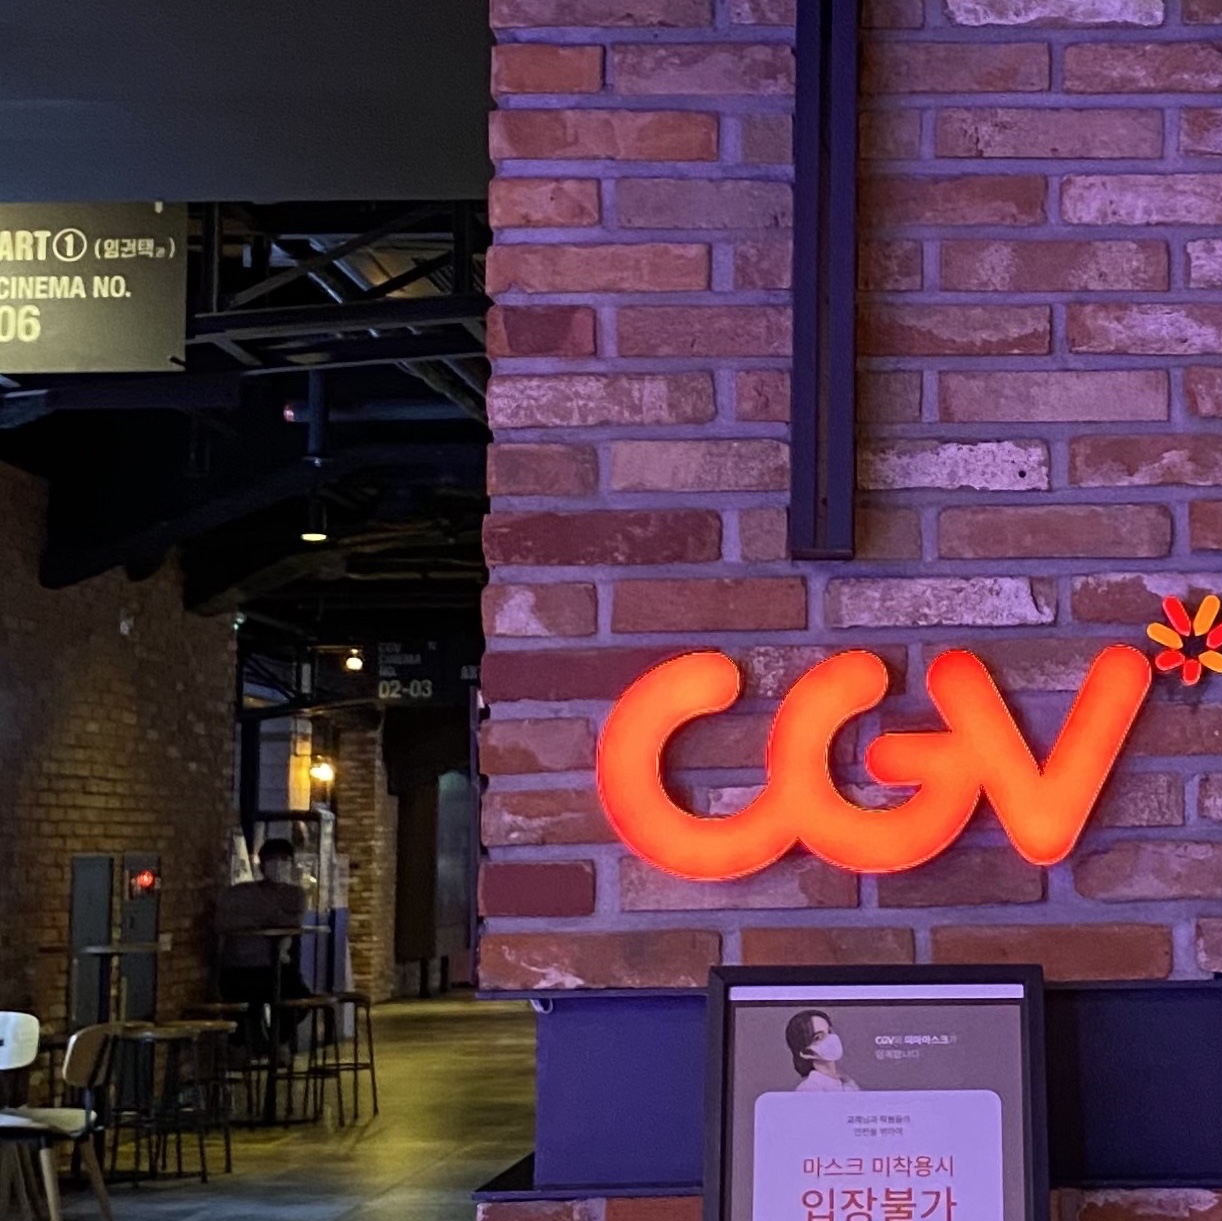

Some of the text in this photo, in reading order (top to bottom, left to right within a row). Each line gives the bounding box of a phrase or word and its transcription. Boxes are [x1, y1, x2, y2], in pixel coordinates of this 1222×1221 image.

[0, 275, 132, 300] CINEMA NO.
[0, 305, 41, 343] 06
[378, 679, 433, 699] 02-03
[595, 644, 1153, 882] CGV
[803, 1155, 955, 1178] 마스크 미착용시
